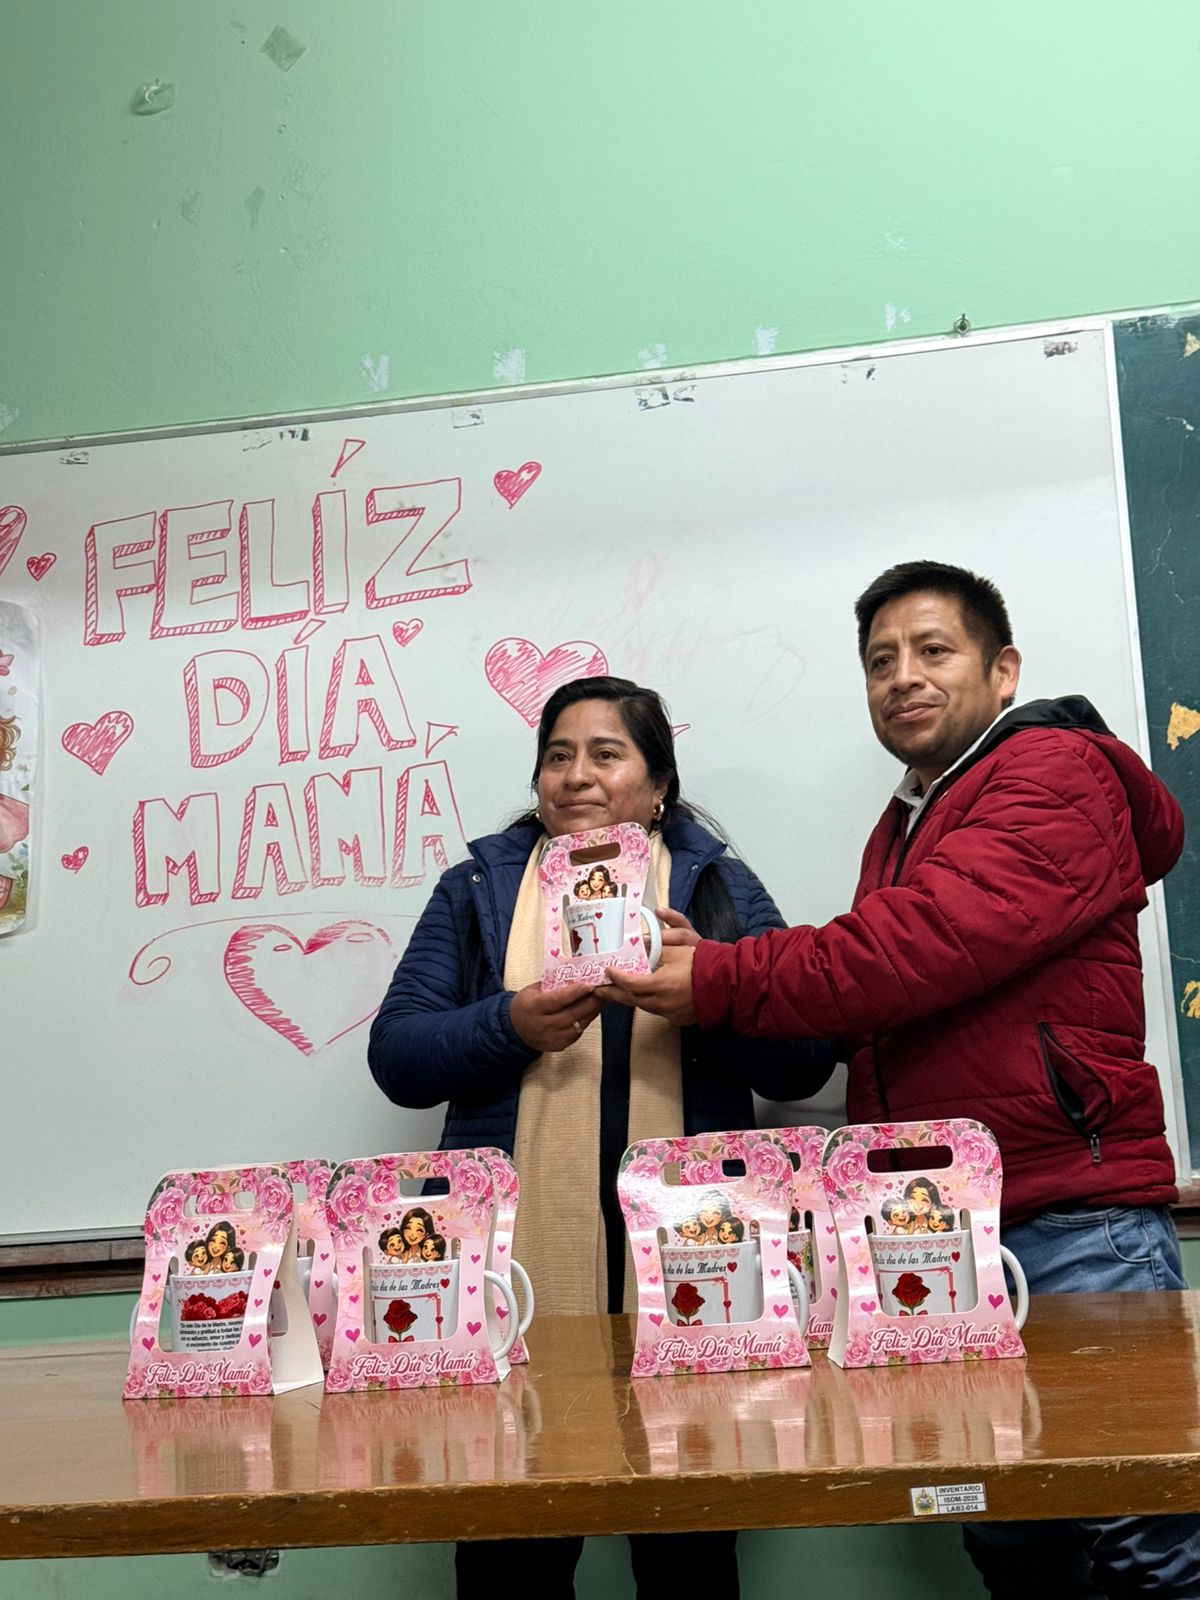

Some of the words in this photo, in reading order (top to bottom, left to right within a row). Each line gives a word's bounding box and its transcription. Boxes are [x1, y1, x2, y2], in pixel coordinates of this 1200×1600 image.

[84, 438, 473, 647] FELÍZ
[183, 618, 417, 769] DÍA
[132, 720, 470, 909] MAMÁ
[684, 1262, 695, 1274] las
[697, 1261, 727, 1274] Madres
[897, 1253, 906, 1264] de
[908, 1252, 919, 1264] las
[921, 1251, 952, 1265] Madres
[398, 1280, 408, 1291] las
[411, 1277, 440, 1291] Madres
[659, 1339, 695, 1361] Feliz
[698, 1337, 729, 1359] Día
[733, 1333, 782, 1356] Mamá
[872, 1328, 908, 1351] Feliz
[912, 1327, 943, 1349] Día
[948, 1323, 997, 1346] Mamá
[146, 1363, 177, 1384] Feliz
[179, 1362, 206, 1383] Día
[209, 1360, 253, 1382] Mamá
[352, 1355, 388, 1377] Feliz
[390, 1353, 421, 1374] Día
[425, 1350, 474, 1373] Mamá
[939, 1485, 981, 1494] INVENTARIO
[946, 1504, 979, 1513] LAB2-014
